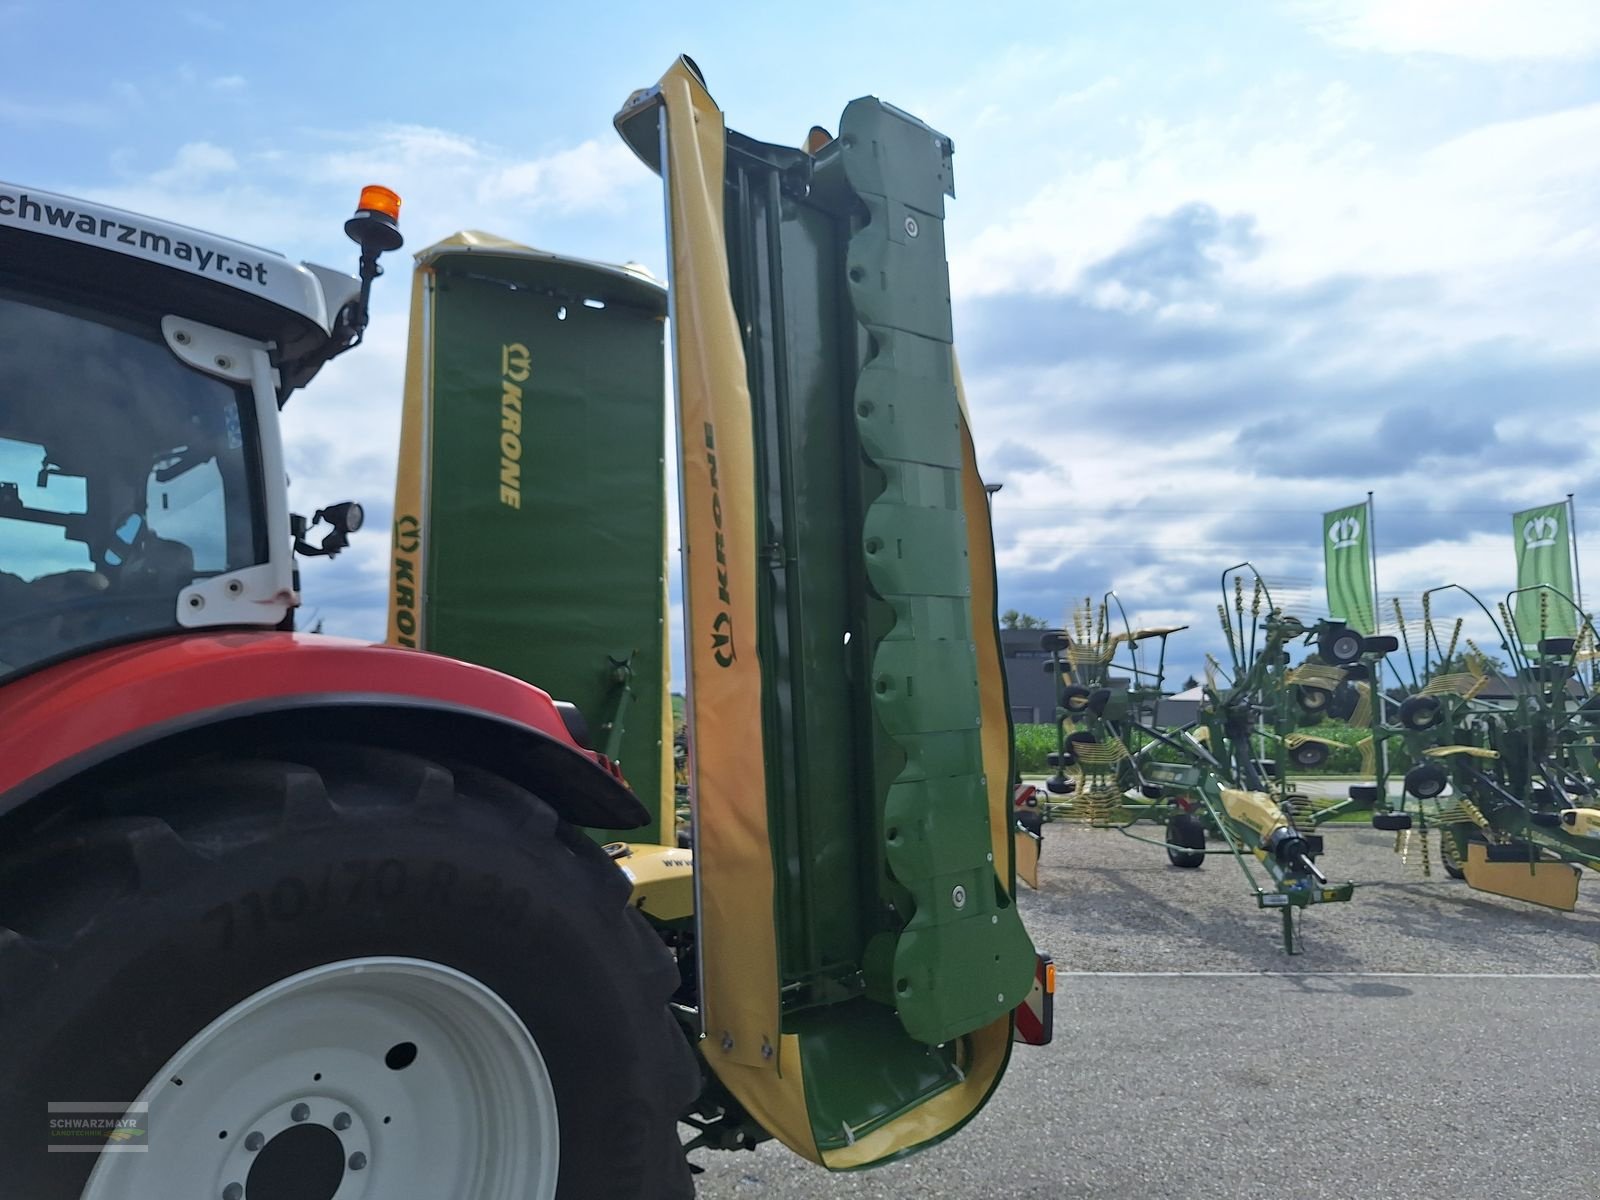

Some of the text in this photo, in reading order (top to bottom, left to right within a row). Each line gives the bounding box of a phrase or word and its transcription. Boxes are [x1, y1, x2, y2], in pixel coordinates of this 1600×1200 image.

[0, 194, 268, 286] chwarzmayr.at
[500, 380, 522, 510] KRONE
[704, 421, 730, 605] KRONE
